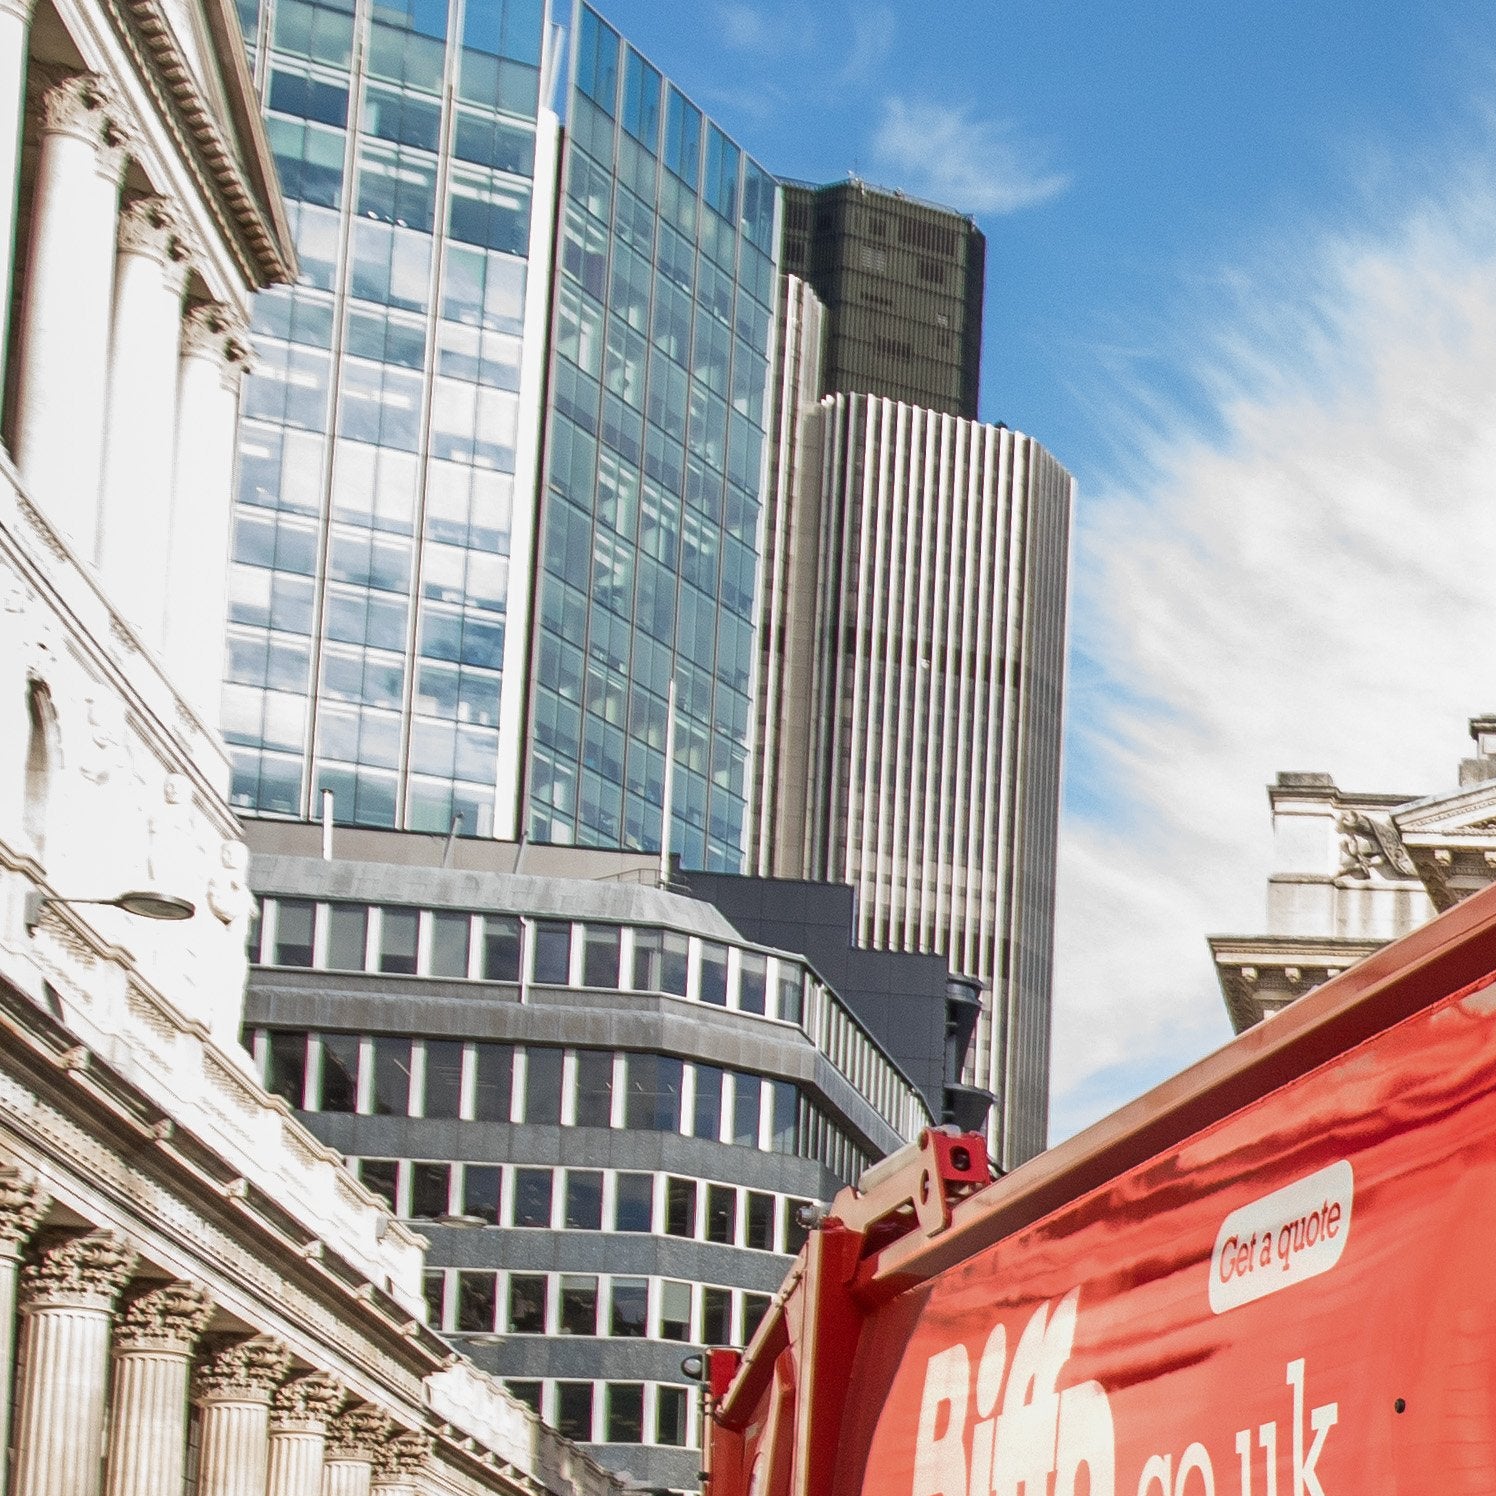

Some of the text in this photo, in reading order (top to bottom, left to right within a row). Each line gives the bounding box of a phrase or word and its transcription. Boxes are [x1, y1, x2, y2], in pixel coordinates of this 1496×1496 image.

[1218, 1198, 1342, 1284] Get a quote
